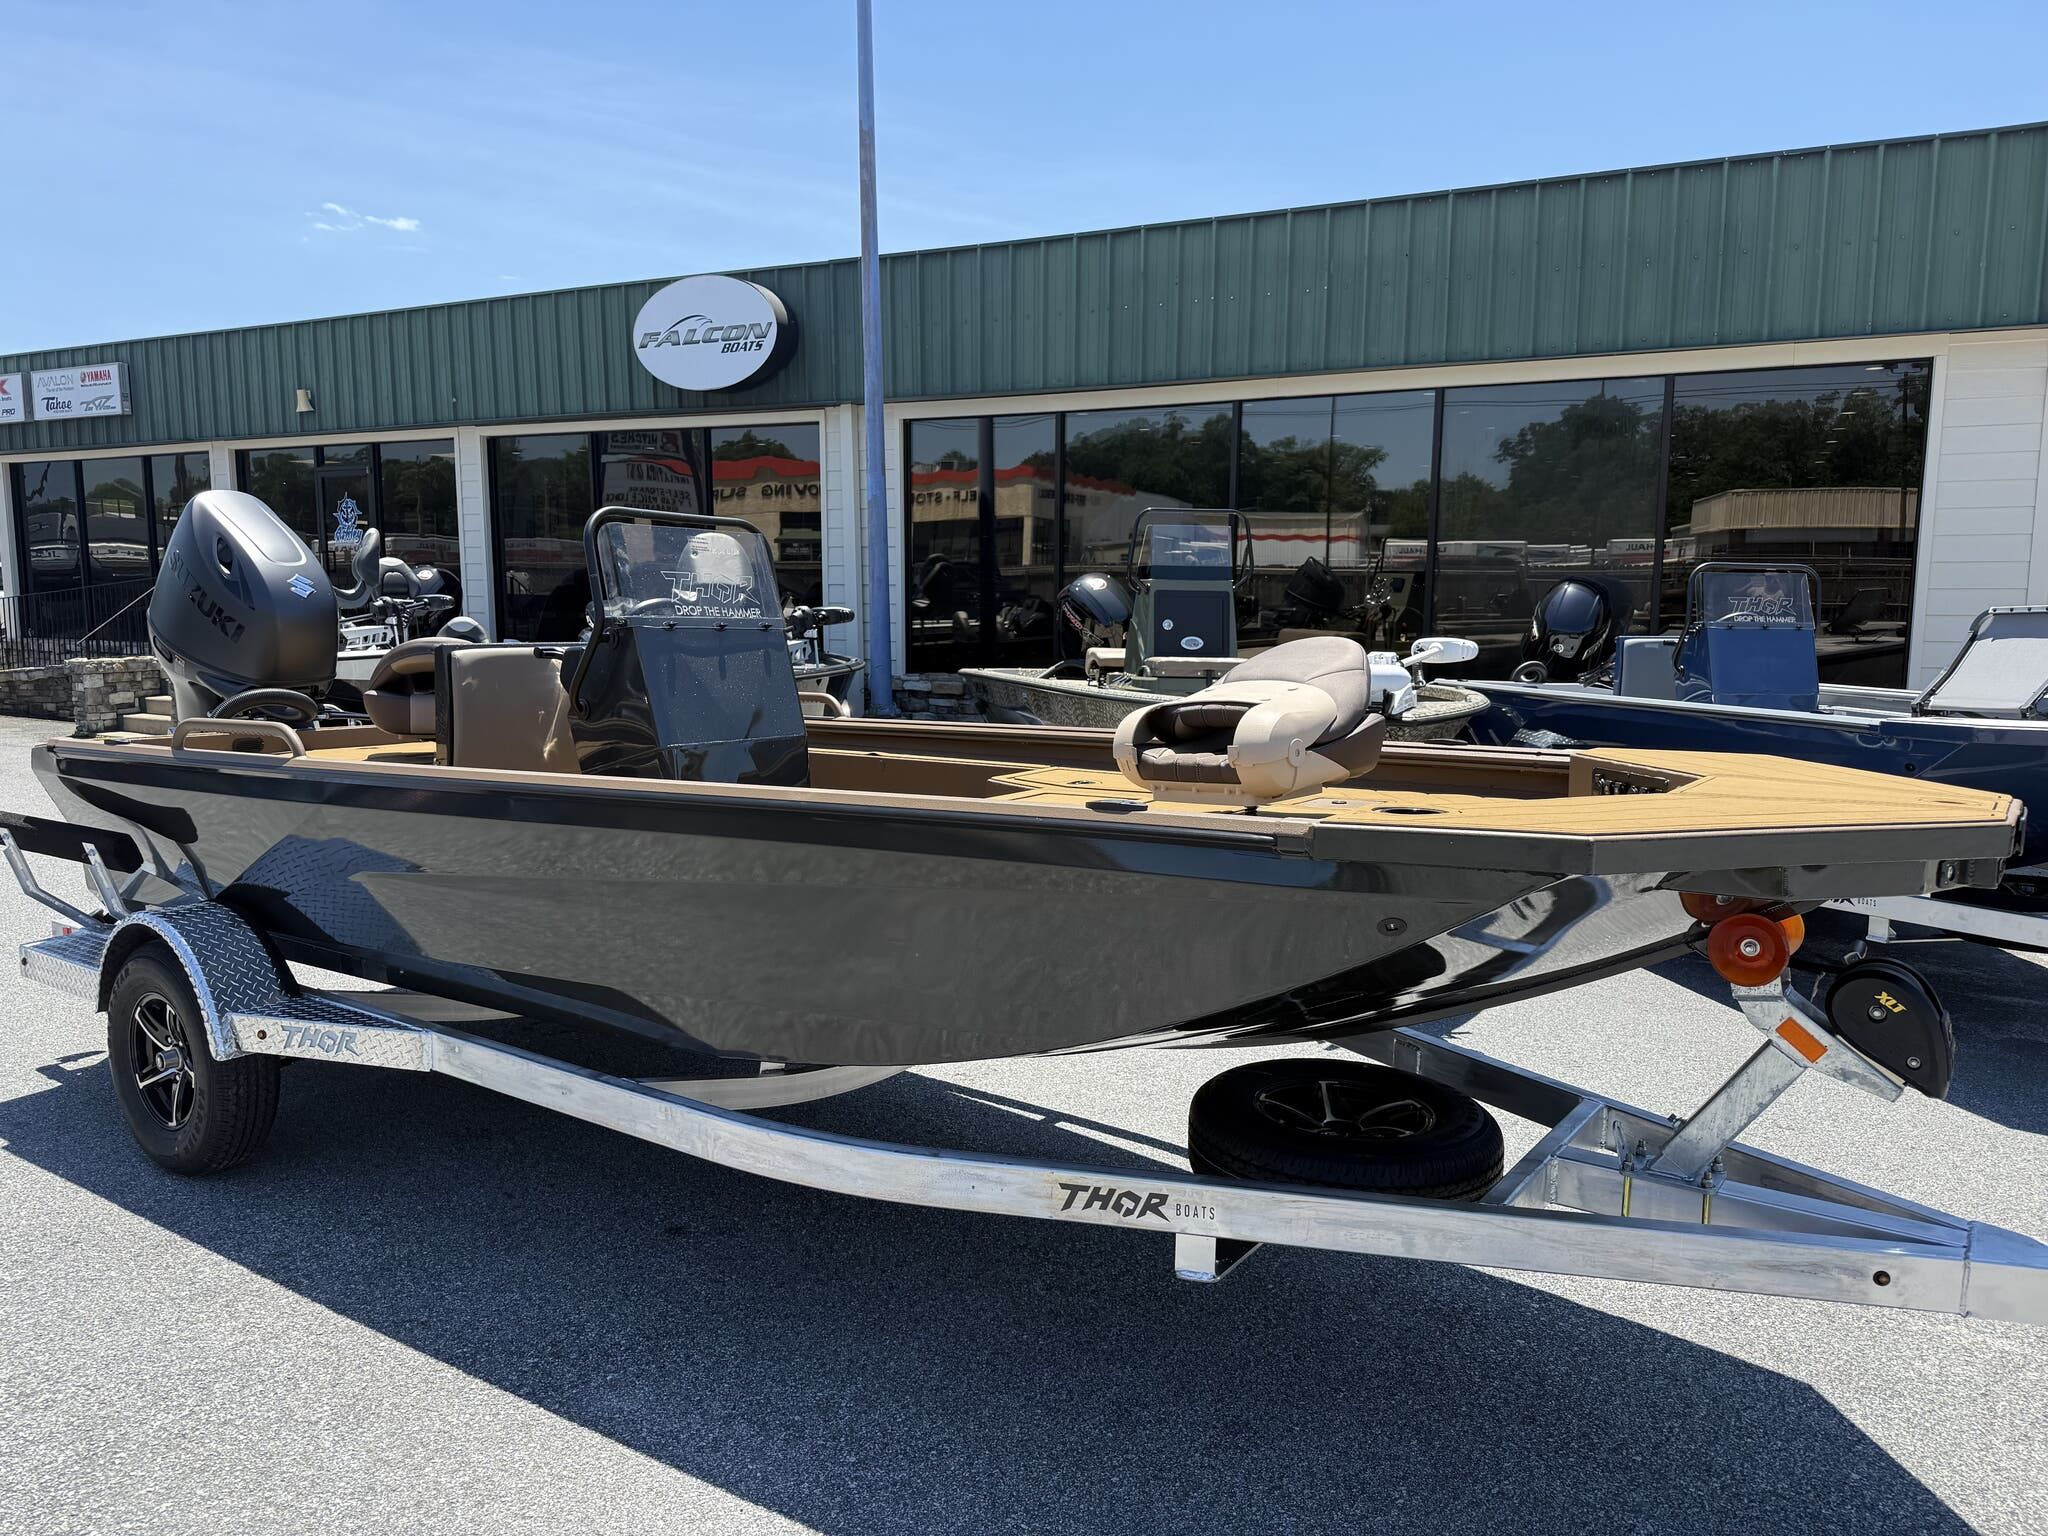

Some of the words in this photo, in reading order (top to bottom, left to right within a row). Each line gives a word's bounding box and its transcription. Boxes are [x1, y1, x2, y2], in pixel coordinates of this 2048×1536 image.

[639, 322, 772, 349] FALCON
[720, 340, 764, 353] BOATS
[37, 374, 74, 388] AVALON
[86, 369, 112, 381] YAMAHA
[2, 408, 16, 416] PRO
[41, 396, 73, 412] Tahoe
[335, 525, 364, 544] Ashley
[661, 571, 760, 604] THOR
[675, 605, 703, 616] DROP
[704, 606, 721, 617] THE
[722, 607, 762, 618] HAMMER
[1728, 596, 1797, 615] THOR
[1874, 991, 1907, 1013] XLT
[281, 1025, 360, 1057] THOR
[1058, 1183, 1171, 1223] THOR
[1175, 1203, 1216, 1220] BOATS
